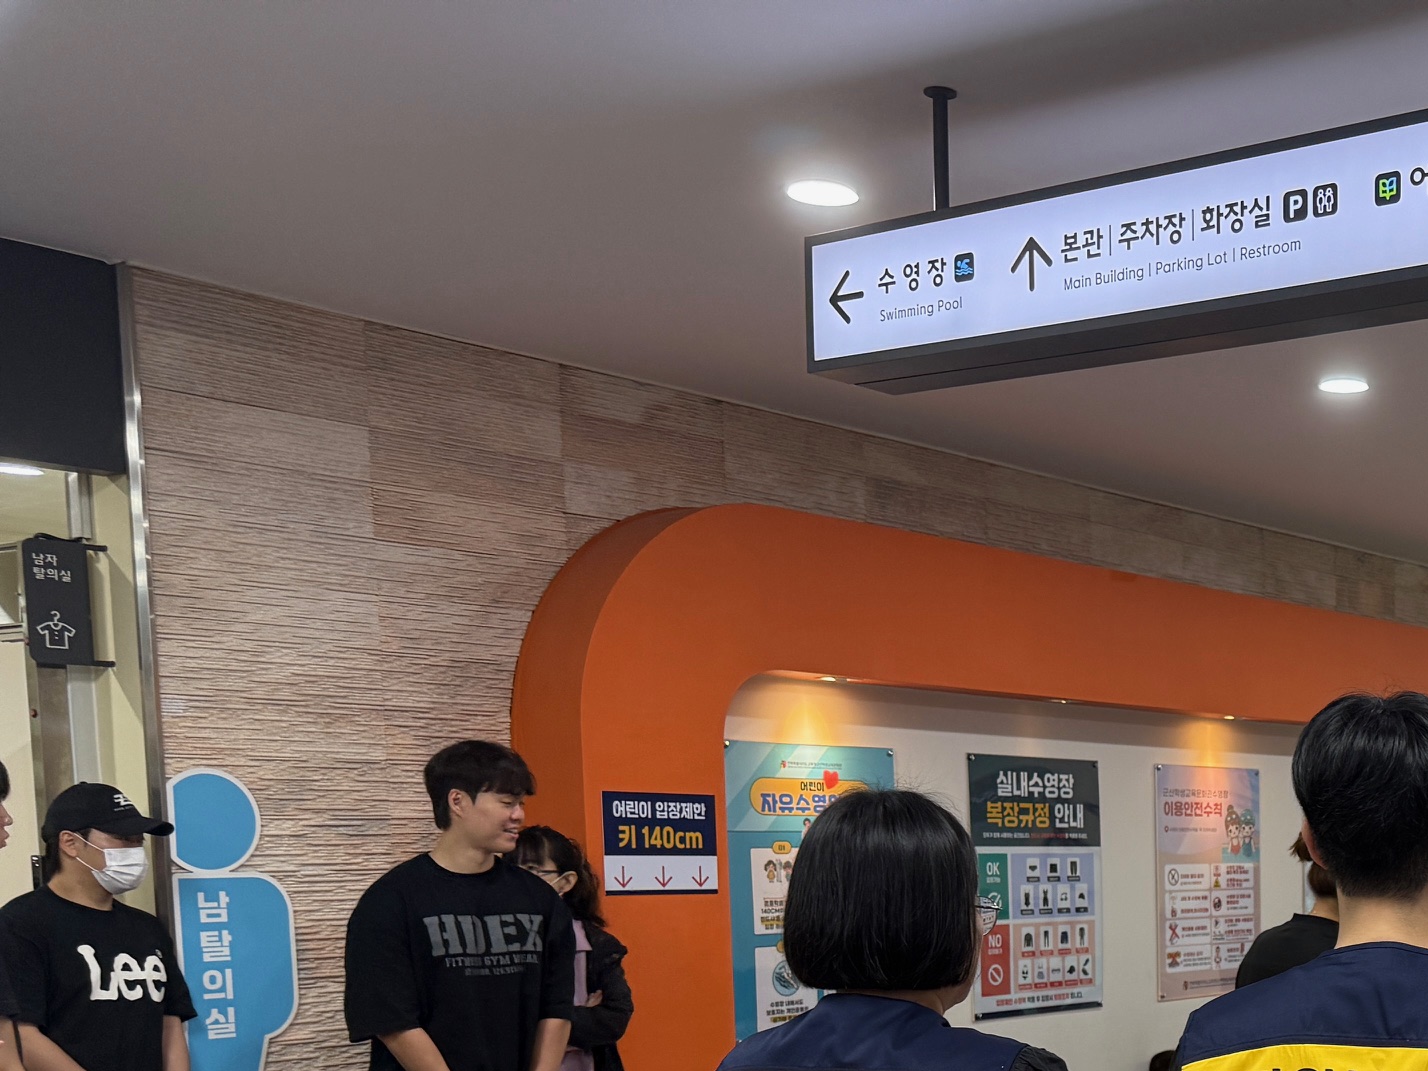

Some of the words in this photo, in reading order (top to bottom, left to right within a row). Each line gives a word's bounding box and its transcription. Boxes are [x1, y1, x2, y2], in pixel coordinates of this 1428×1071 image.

[1060, 228, 1104, 264] 본관
[1118, 211, 1186, 251] 주차장
[1200, 195, 1271, 234] 화장실
[877, 257, 947, 295] 수영장
[1063, 274, 1092, 291] Main
[1095, 267, 1144, 286] Building
[1156, 256, 1203, 276] Parking
[1207, 251, 1228, 266] Lot
[1240, 239, 1302, 261] Restroom
[879, 301, 934, 322] Swimming
[937, 296, 963, 313] Pool
[32, 552, 58, 567] 남자
[33, 566, 72, 583] 탈의실
[800, 781, 825, 792] 어린이
[996, 771, 1075, 799] 실내수영장
[612, 800, 652, 819] 어린이
[655, 802, 707, 820] 입장제한
[986, 801, 1050, 828] 복장규정
[1054, 803, 1085, 829] 안내
[1163, 801, 1223, 818] 이용안전수칙
[618, 825, 637, 850] 키
[642, 825, 704, 850] 140cm
[986, 861, 1000, 875] OK
[422, 913, 544, 957] HDEX
[988, 934, 1003, 948] NO
[197, 890, 237, 1040] 남탈의실
[484, 954, 511, 966] GYM
[76, 944, 168, 1003] Lee
